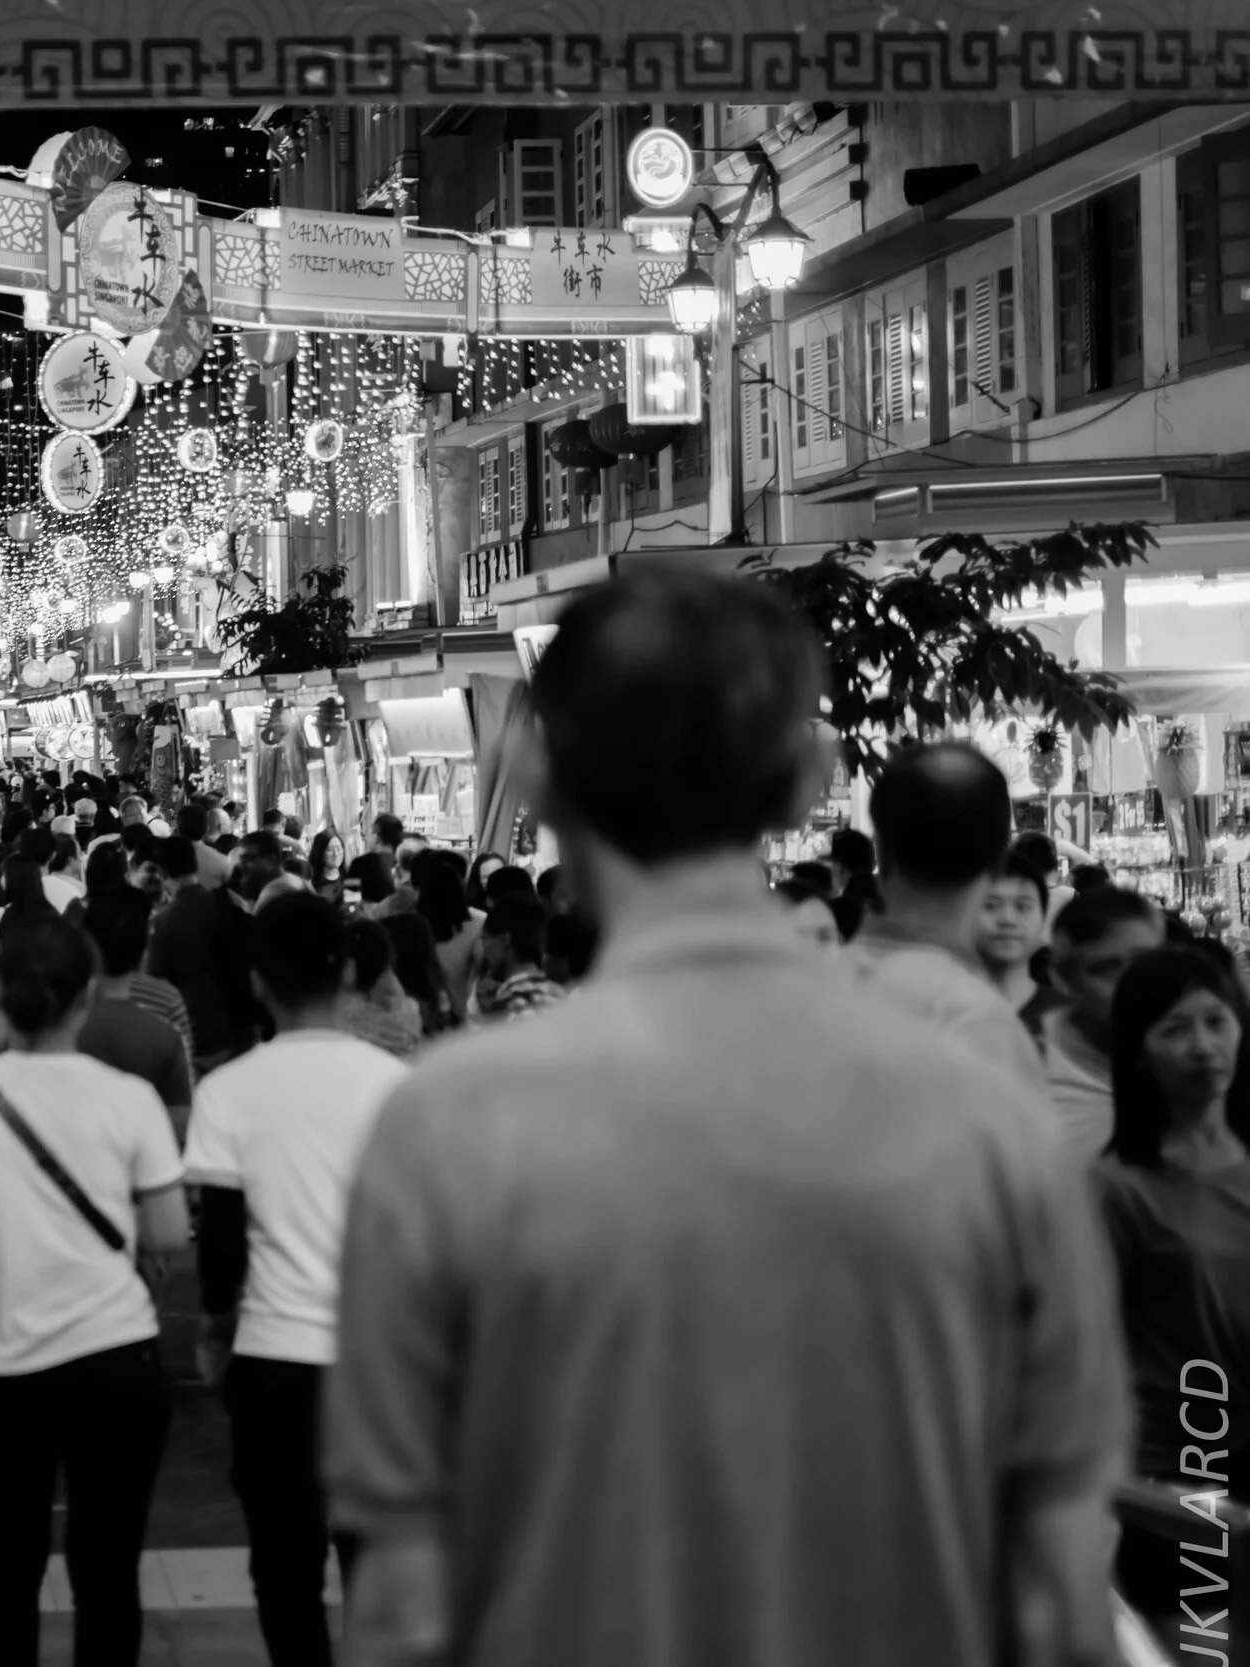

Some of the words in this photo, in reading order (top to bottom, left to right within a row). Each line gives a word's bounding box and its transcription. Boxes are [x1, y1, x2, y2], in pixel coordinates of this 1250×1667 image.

[288, 221, 393, 249] CHINATOWN
[288, 253, 337, 273] STREET
[338, 258, 395, 277] MARKET
[1053, 799, 1086, 846] $1
